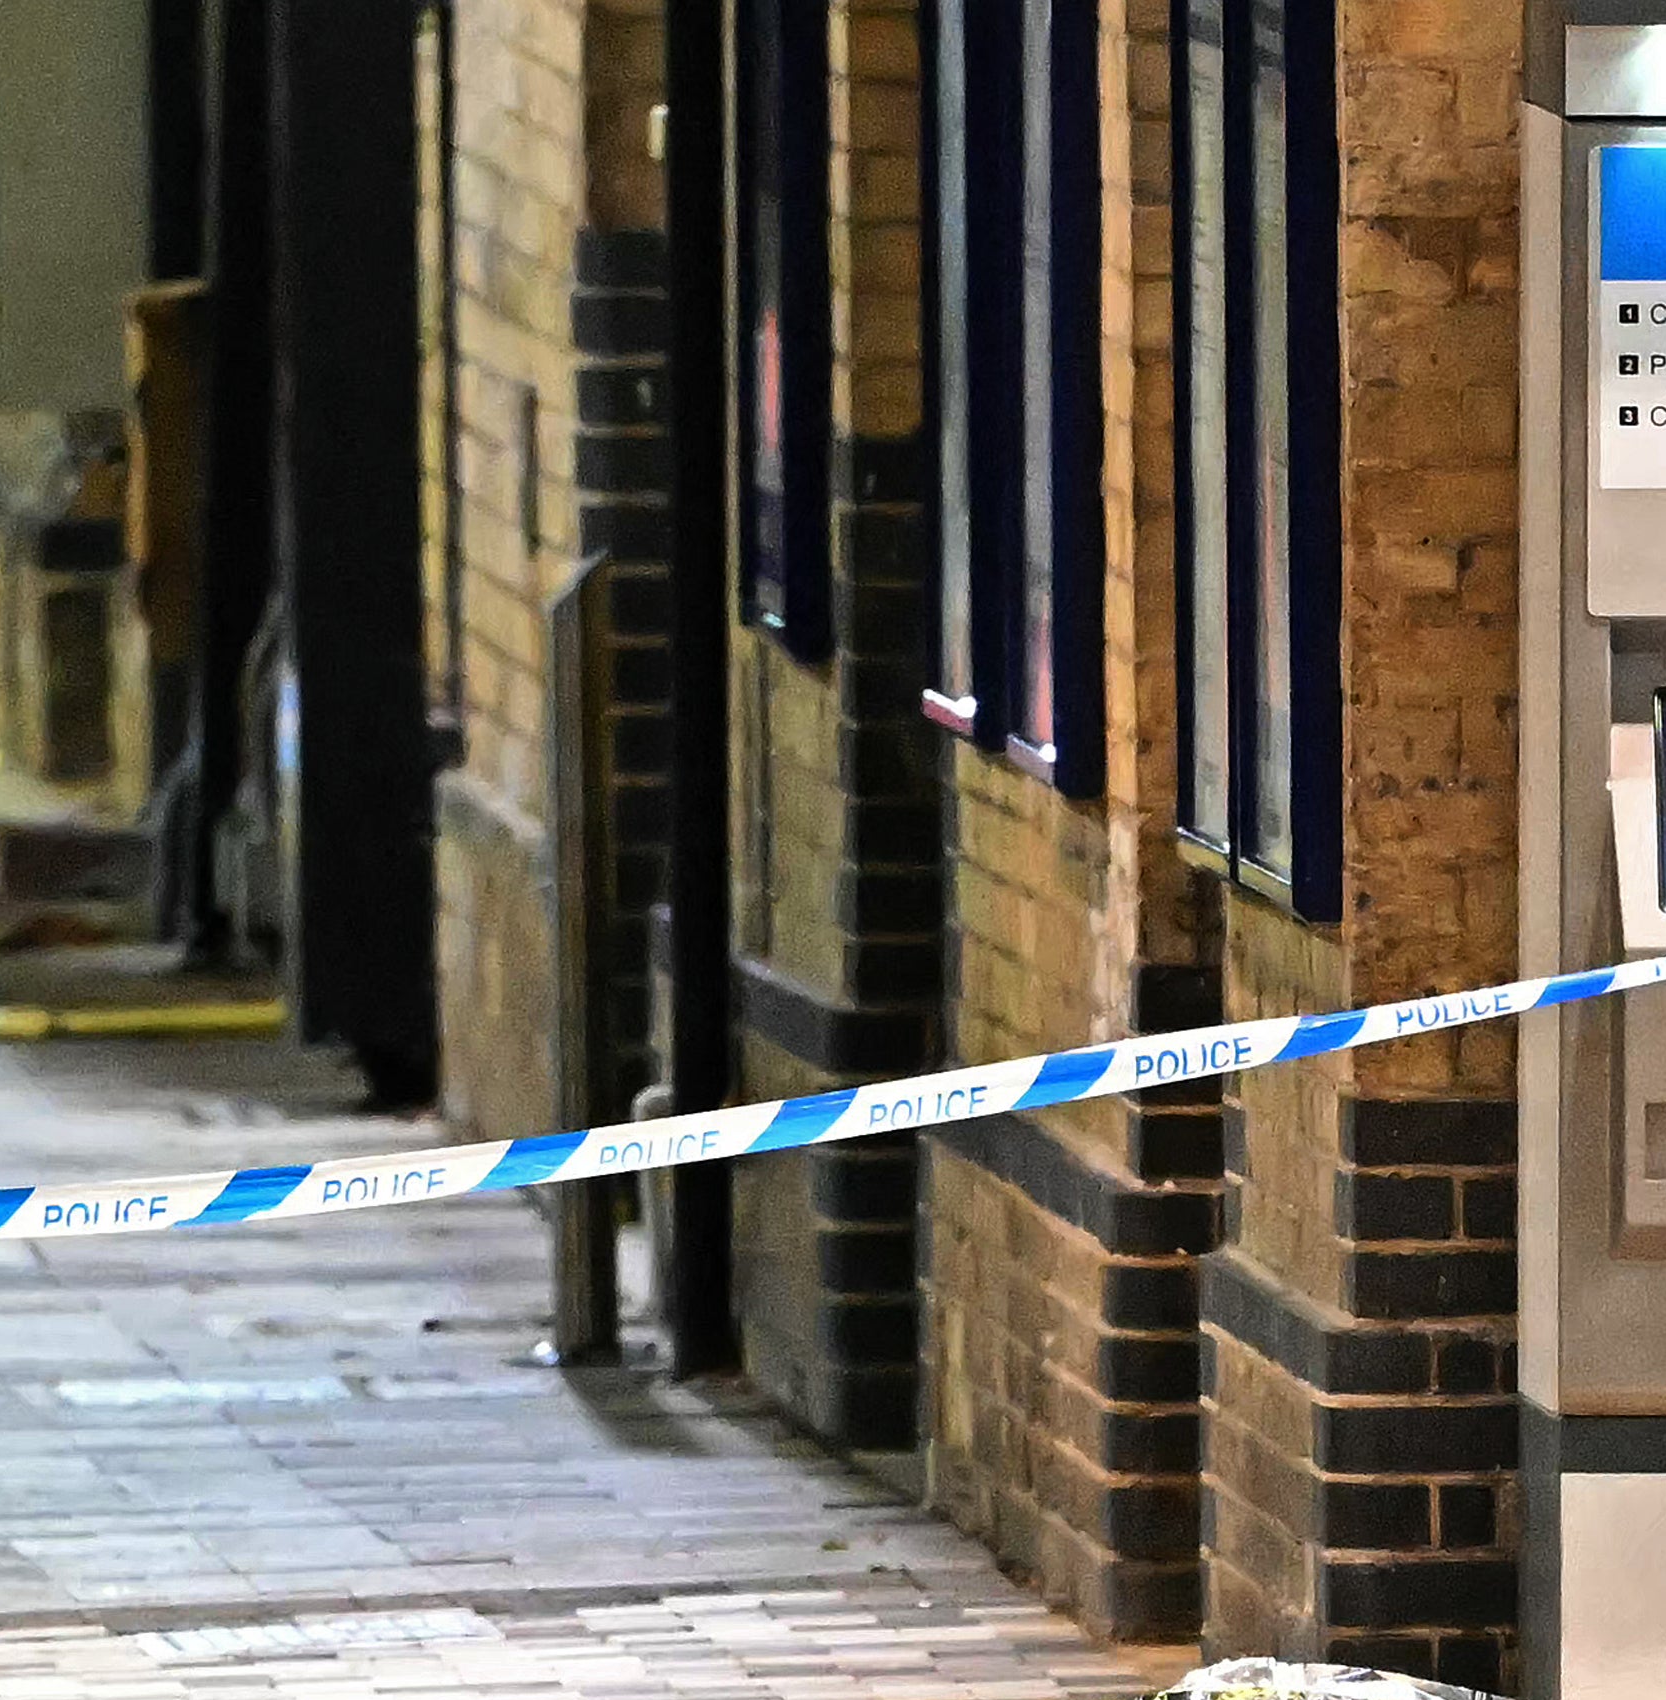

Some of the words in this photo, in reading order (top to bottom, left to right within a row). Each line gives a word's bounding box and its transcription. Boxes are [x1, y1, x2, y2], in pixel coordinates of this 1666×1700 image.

[322, 1168, 445, 1204] POLICE
[599, 1130, 721, 1169] POLICE
[869, 1085, 988, 1128] POLICE
[1135, 1036, 1252, 1084] POLICE
[1395, 993, 1513, 1033] POLICE
